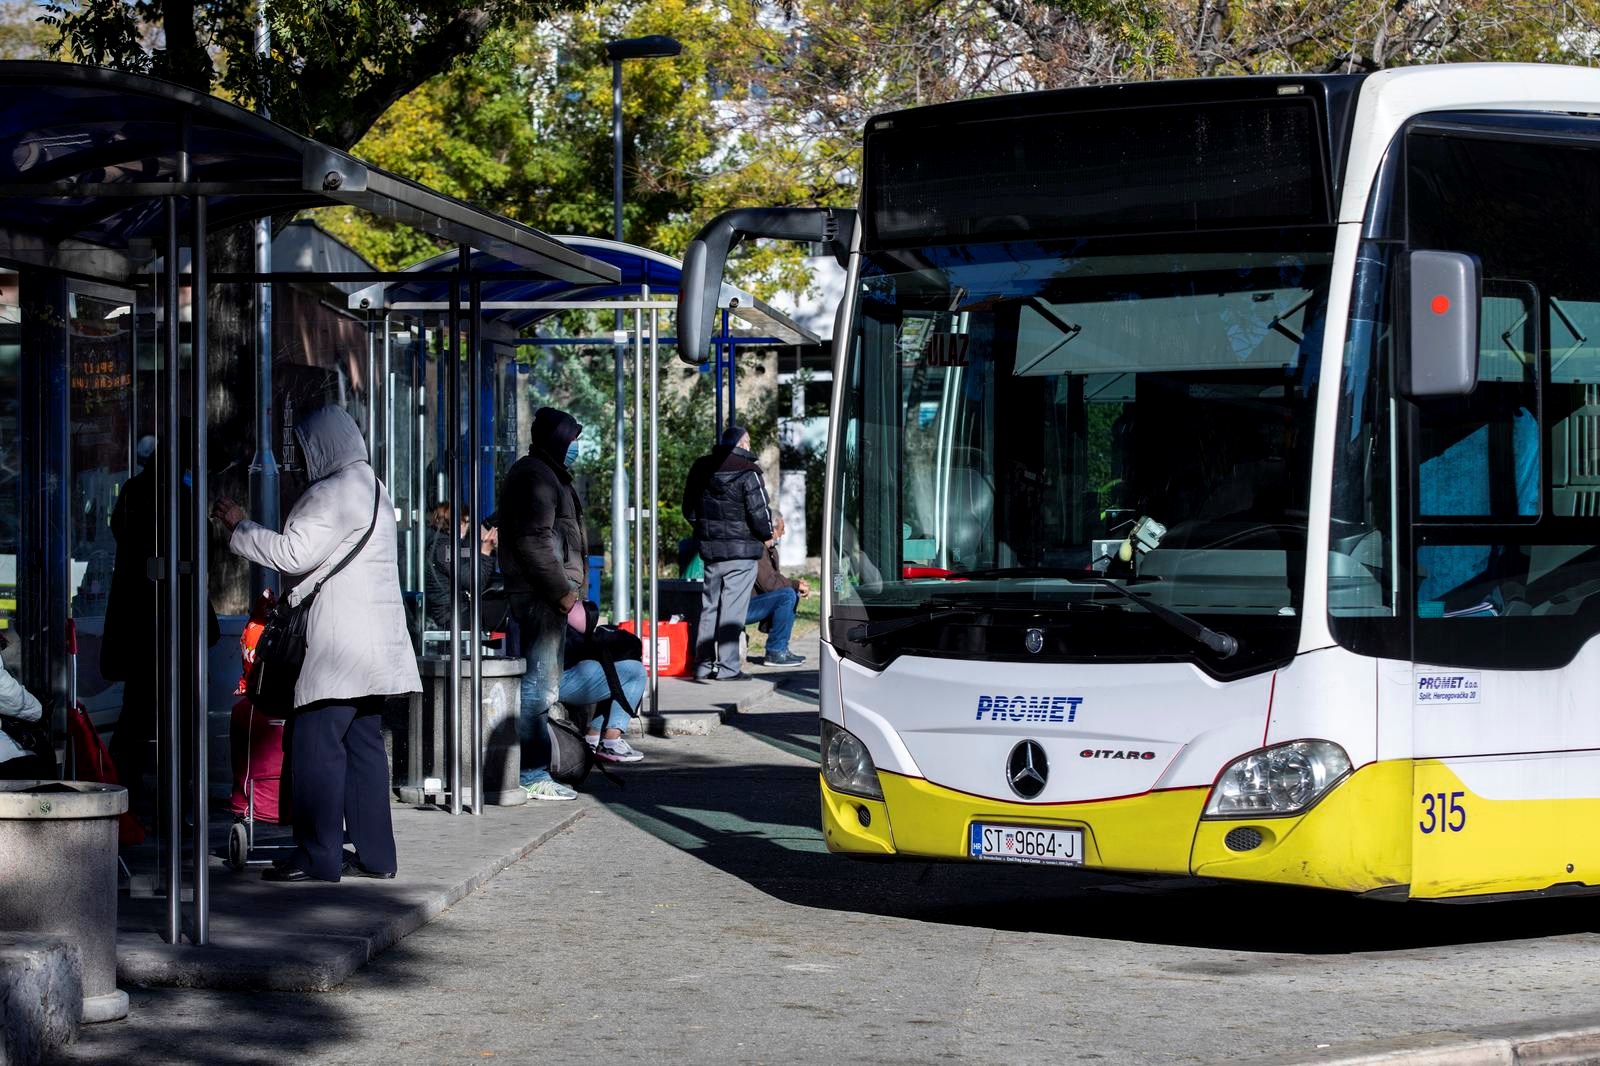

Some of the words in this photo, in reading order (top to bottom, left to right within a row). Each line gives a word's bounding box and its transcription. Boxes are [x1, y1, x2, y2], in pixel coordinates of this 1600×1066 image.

[1419, 676, 1464, 689] PROMET
[1464, 680, 1478, 689] d.o.o.
[1433, 691, 1469, 701] Hercegovačka
[1469, 691, 1476, 699] 20
[976, 695, 1084, 723] PROMET
[1079, 749, 1156, 760] CITARO
[1419, 791, 1466, 834] 315
[984, 829, 1003, 852] ST
[1015, 831, 1074, 858] 9664-J
